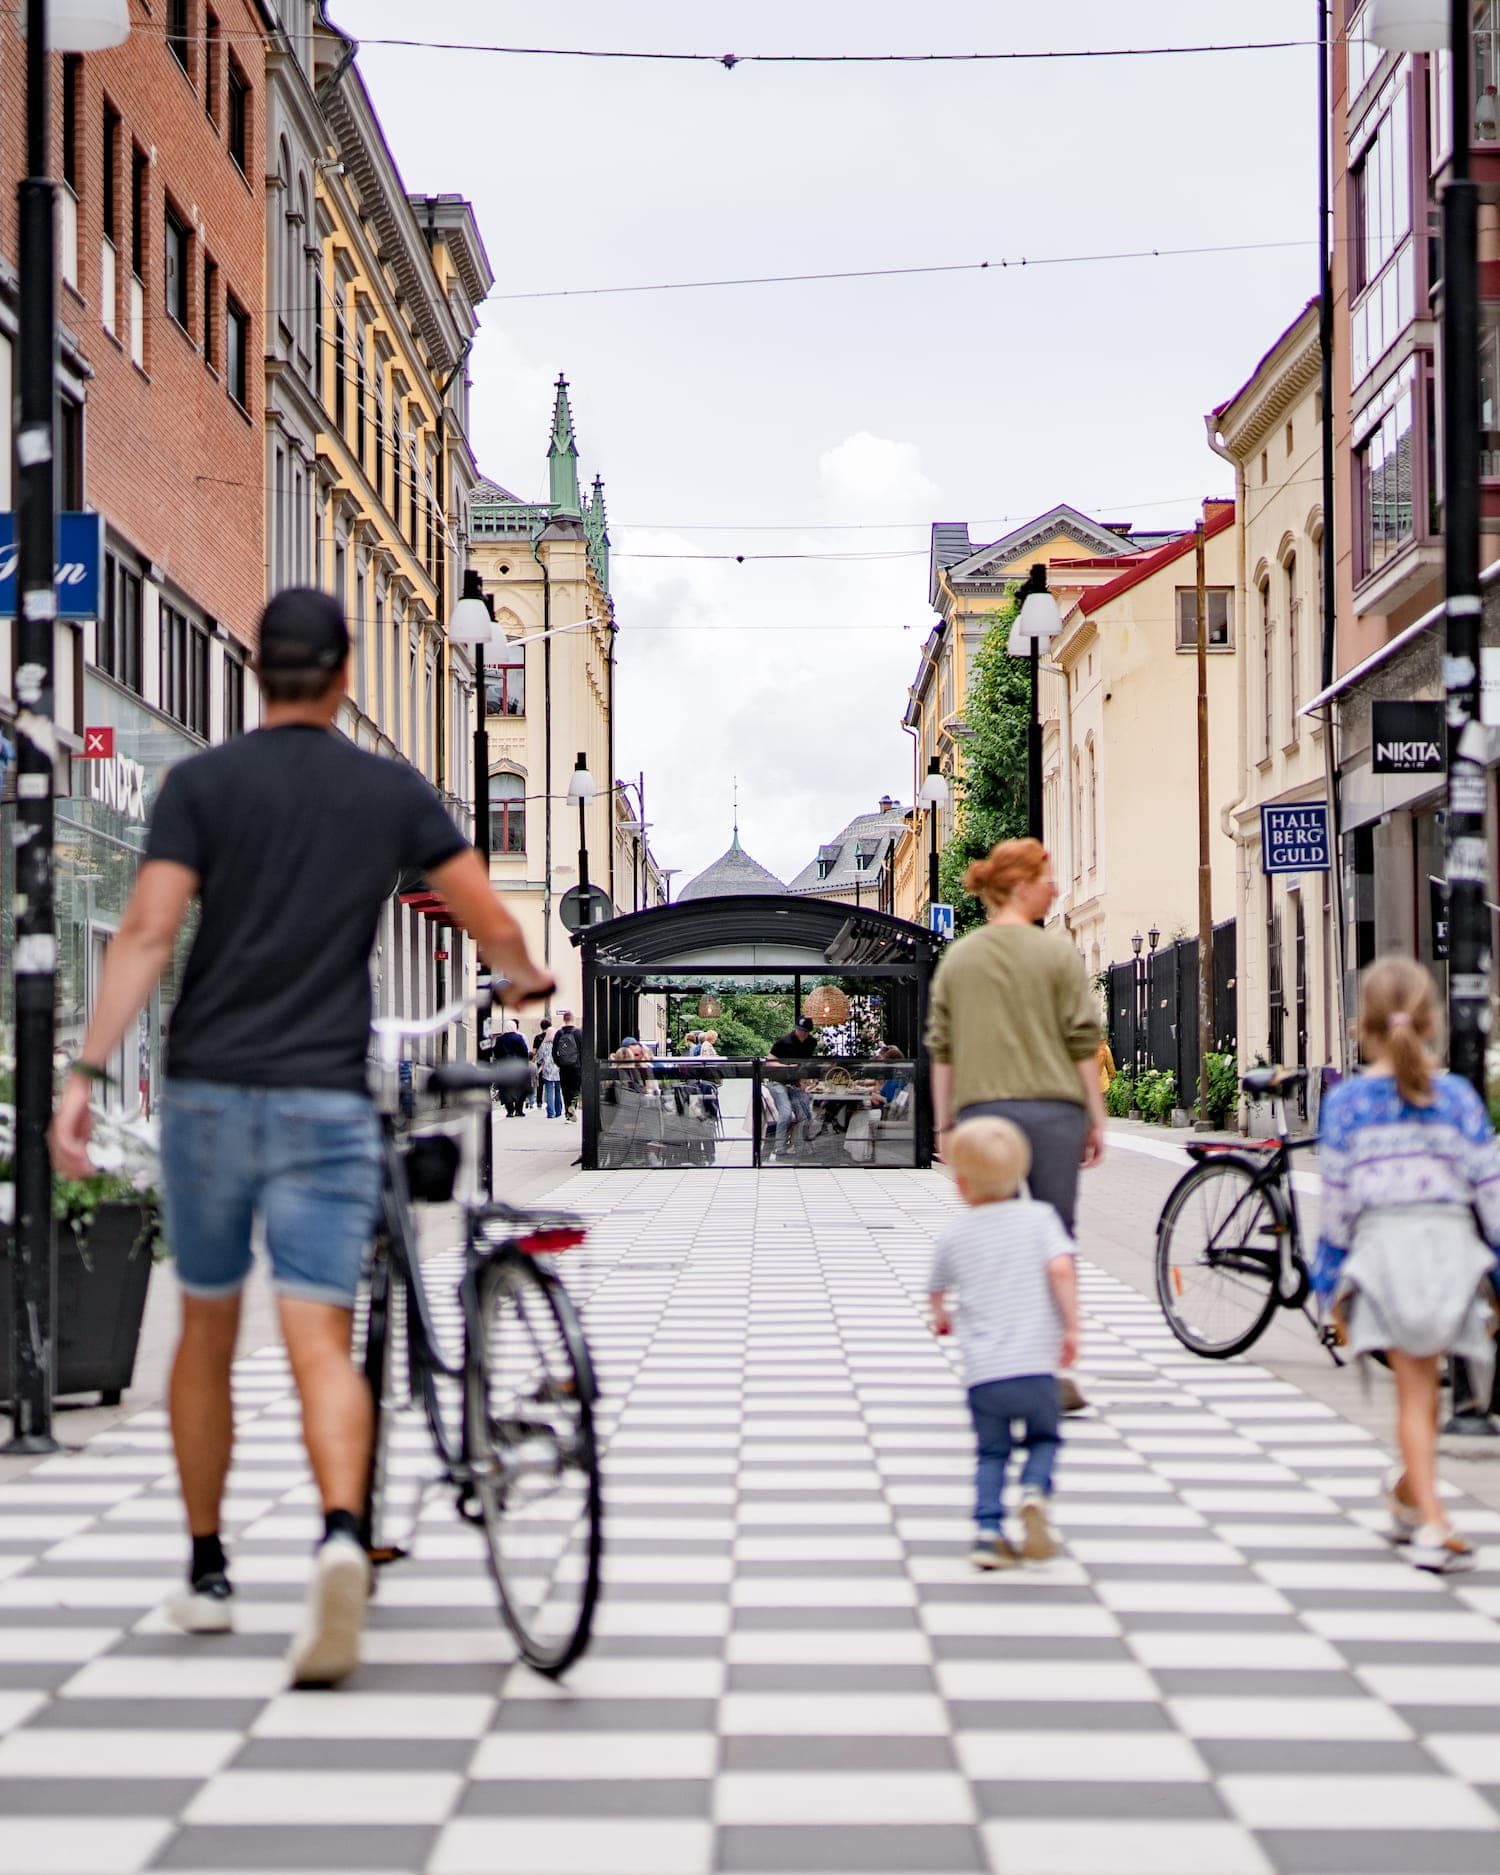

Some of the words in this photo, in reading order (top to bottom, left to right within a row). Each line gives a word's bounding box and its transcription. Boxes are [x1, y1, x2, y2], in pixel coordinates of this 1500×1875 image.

[1377, 742, 1441, 761] NIKITA
[91, 752, 146, 822] LINDEX
[1272, 813, 1321, 829] HALL
[1272, 847, 1324, 863] GULD
